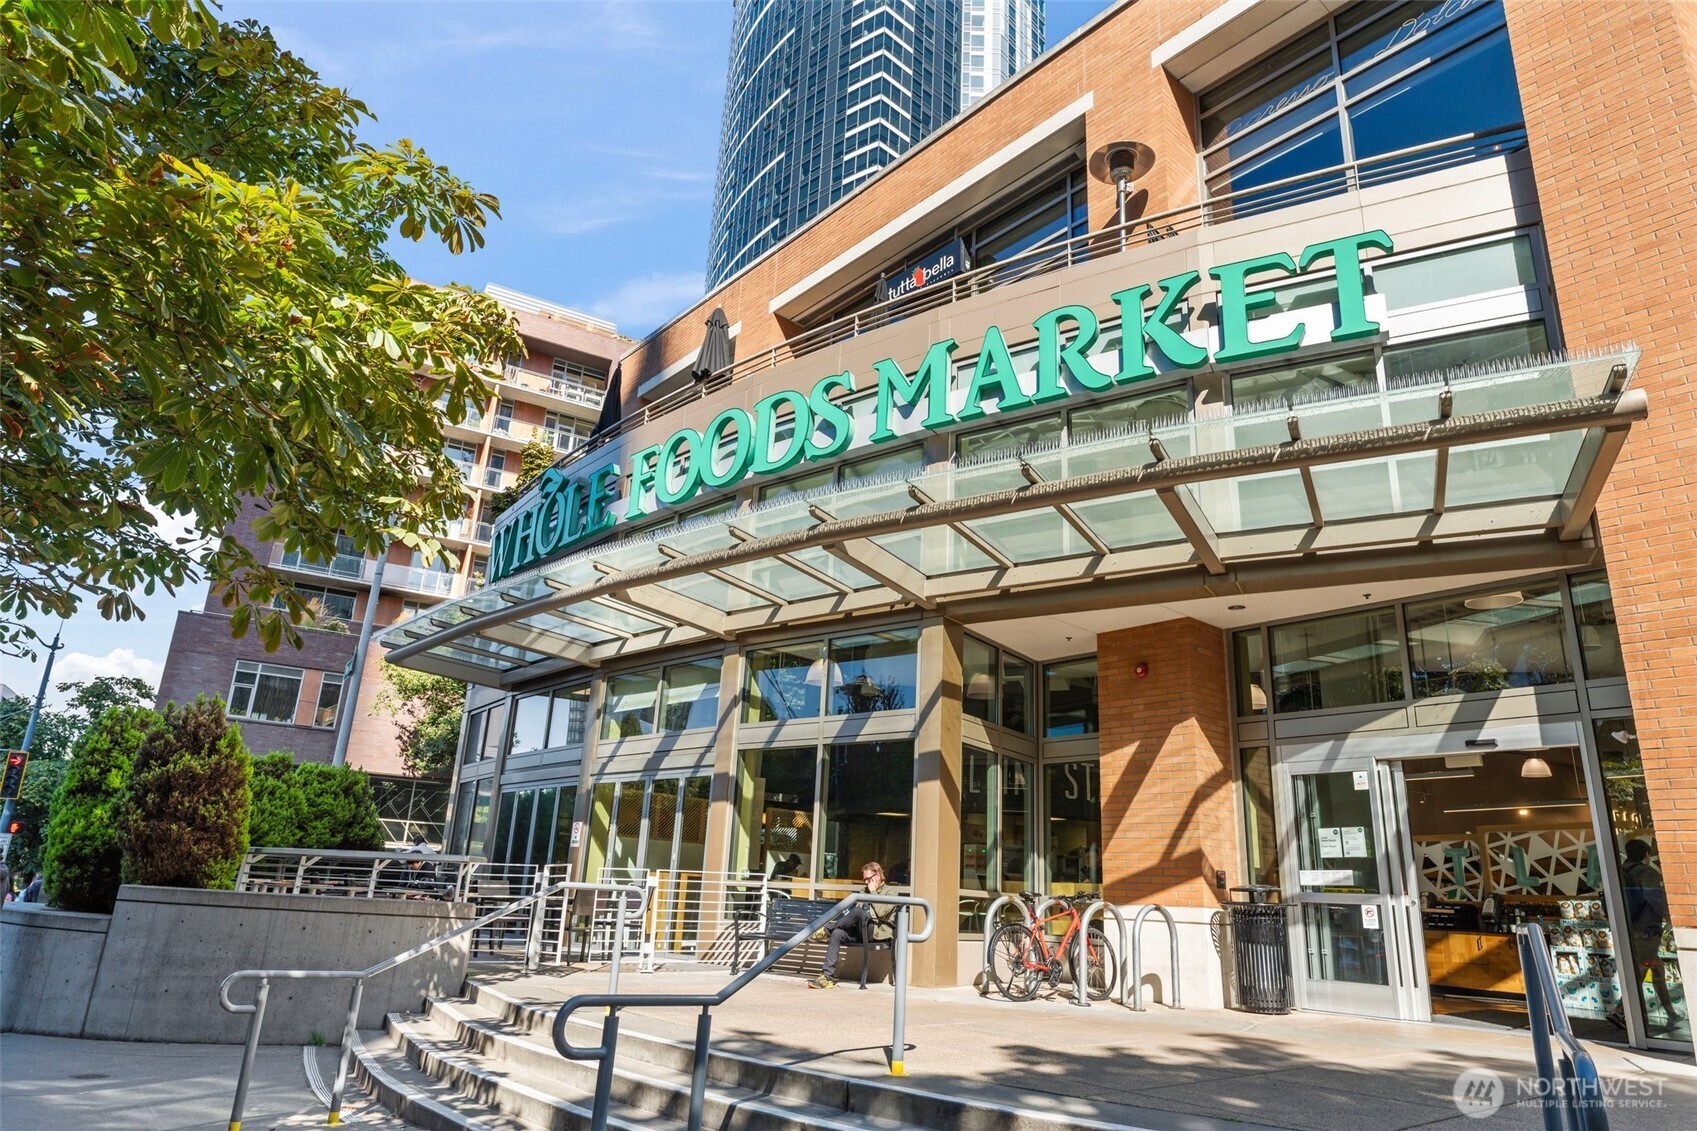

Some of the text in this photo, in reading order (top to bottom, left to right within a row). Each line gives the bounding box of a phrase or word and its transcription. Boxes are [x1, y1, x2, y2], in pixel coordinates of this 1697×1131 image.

[888, 276, 917, 301] tutta
[923, 255, 954, 281] bella
[490, 228, 1395, 583] WHOLE FOODS MARKET
